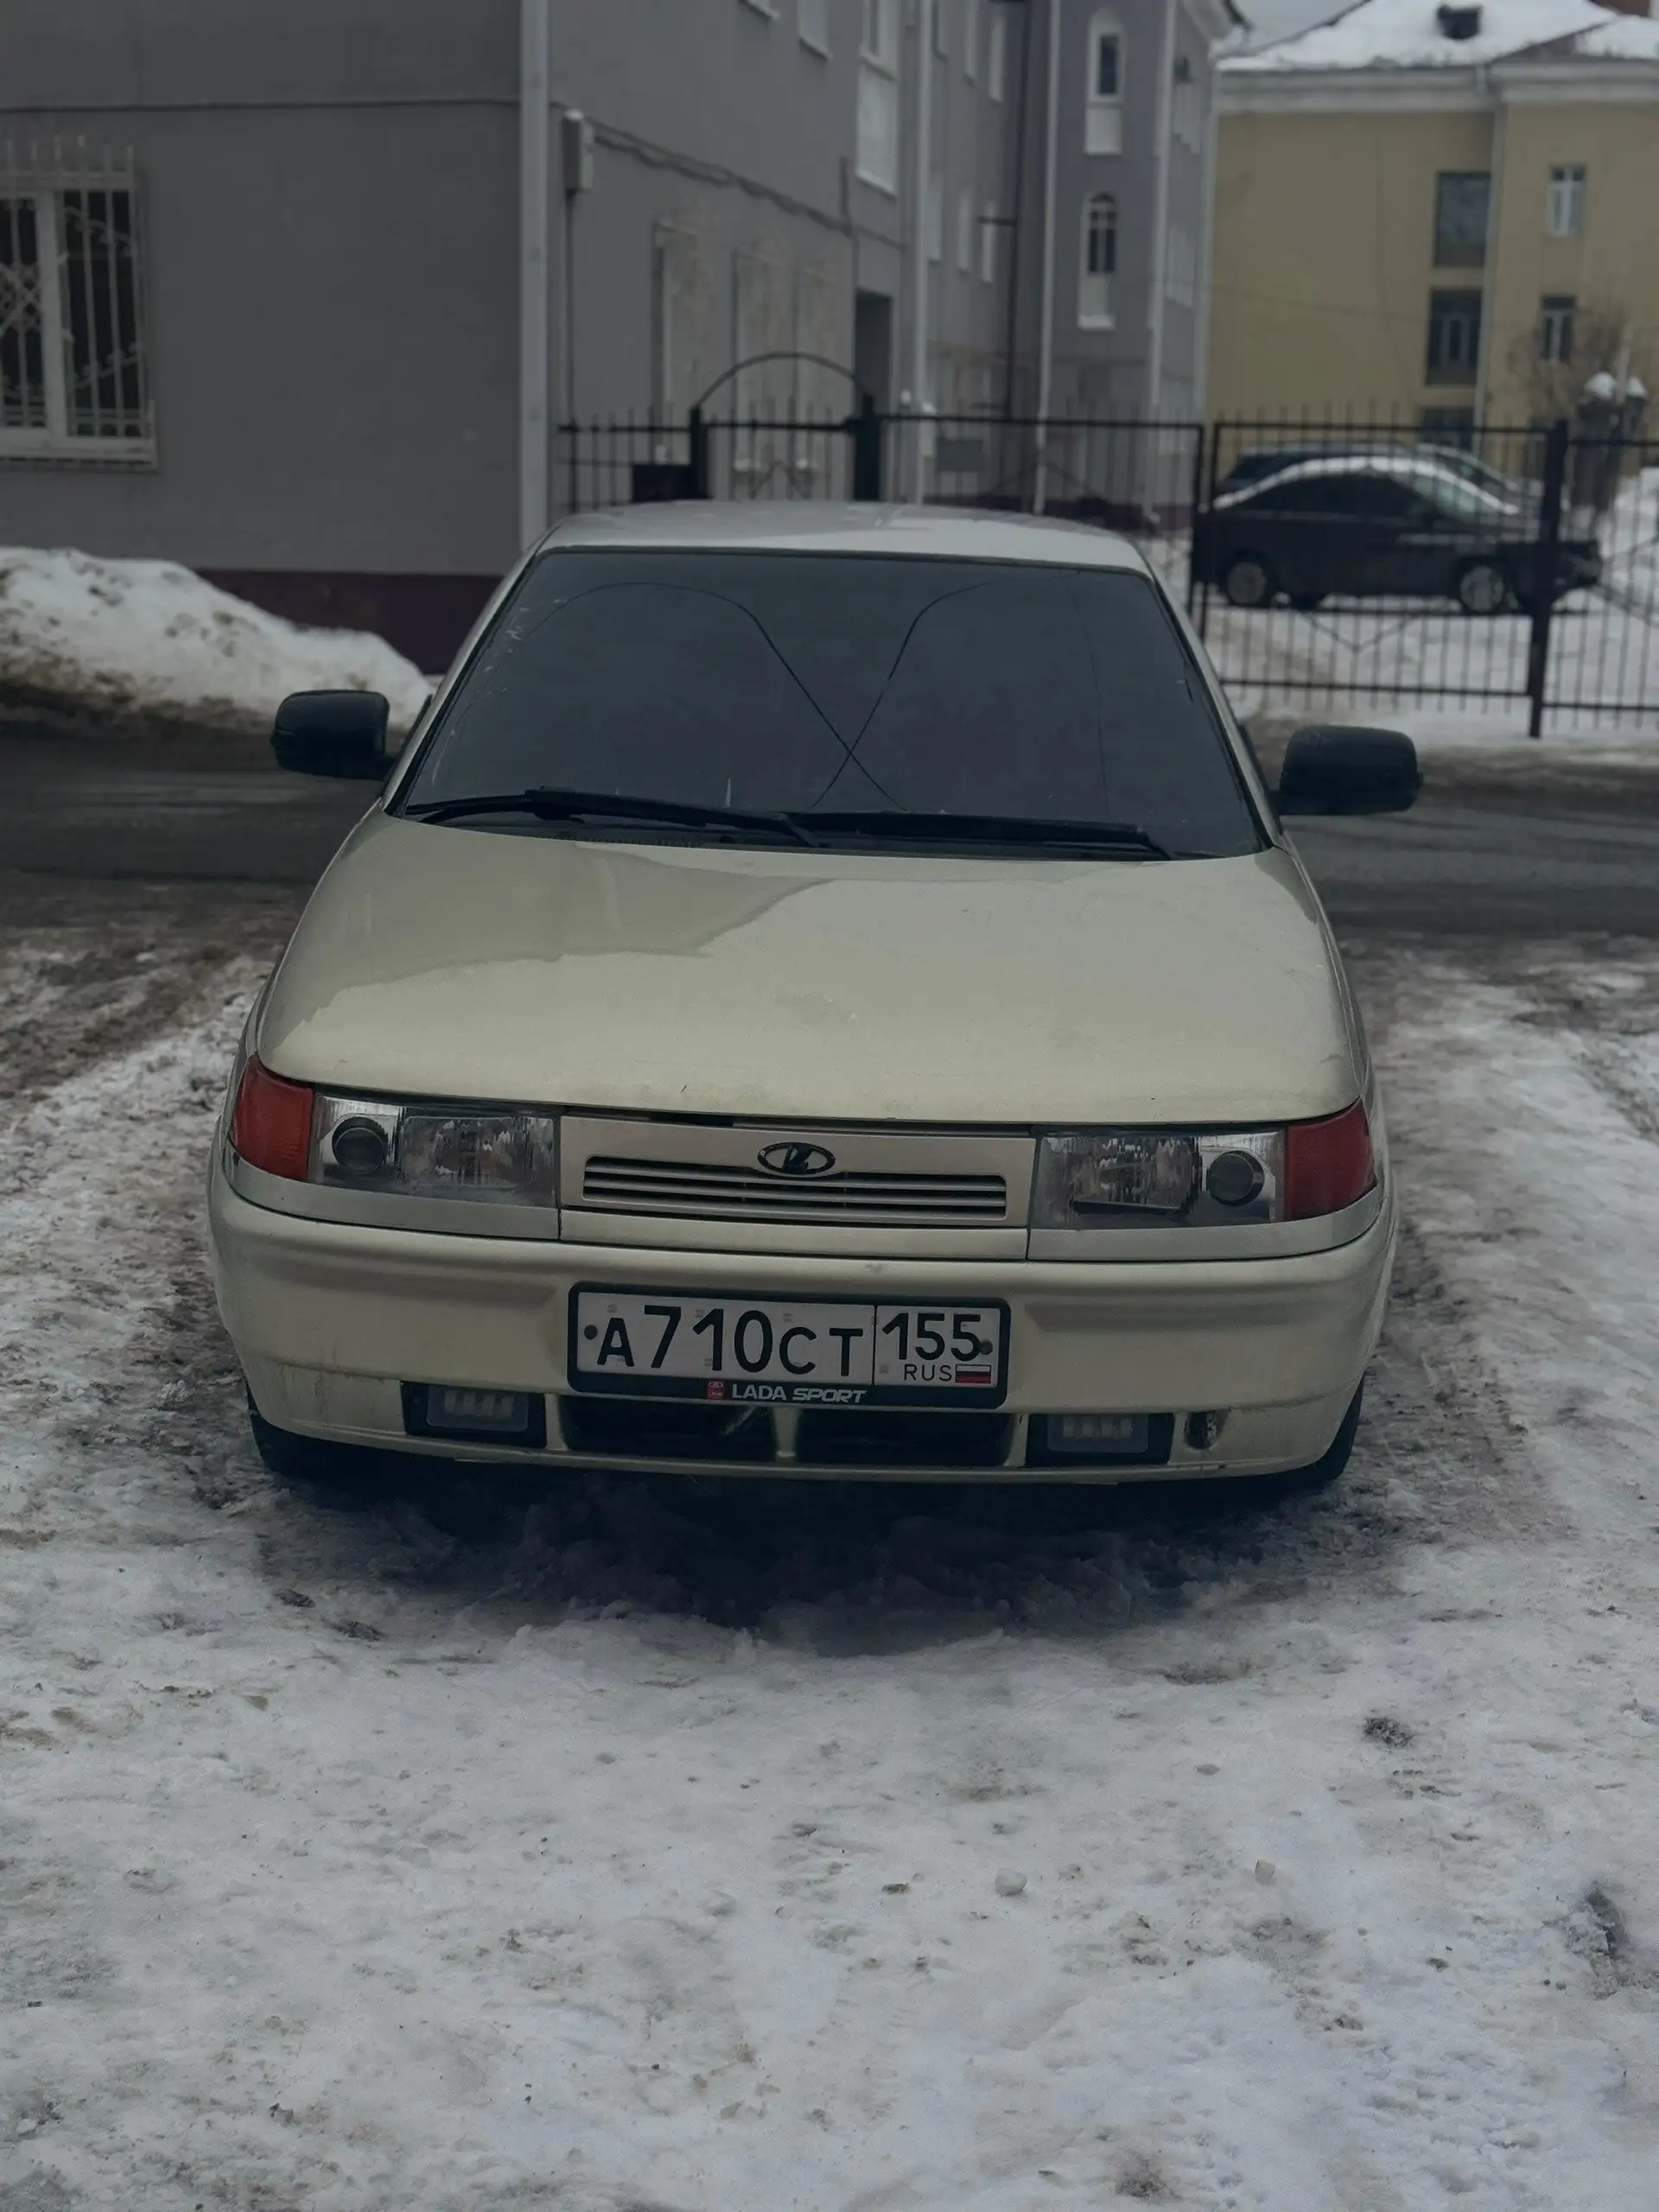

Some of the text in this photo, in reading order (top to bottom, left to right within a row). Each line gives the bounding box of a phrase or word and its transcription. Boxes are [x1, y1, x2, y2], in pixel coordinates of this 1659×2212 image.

[596, 1304, 982, 1377] А710СТ 155
[903, 1363, 952, 1382] RUS
[732, 1383, 787, 1401] LADA
[792, 1388, 868, 1404] SPORT
